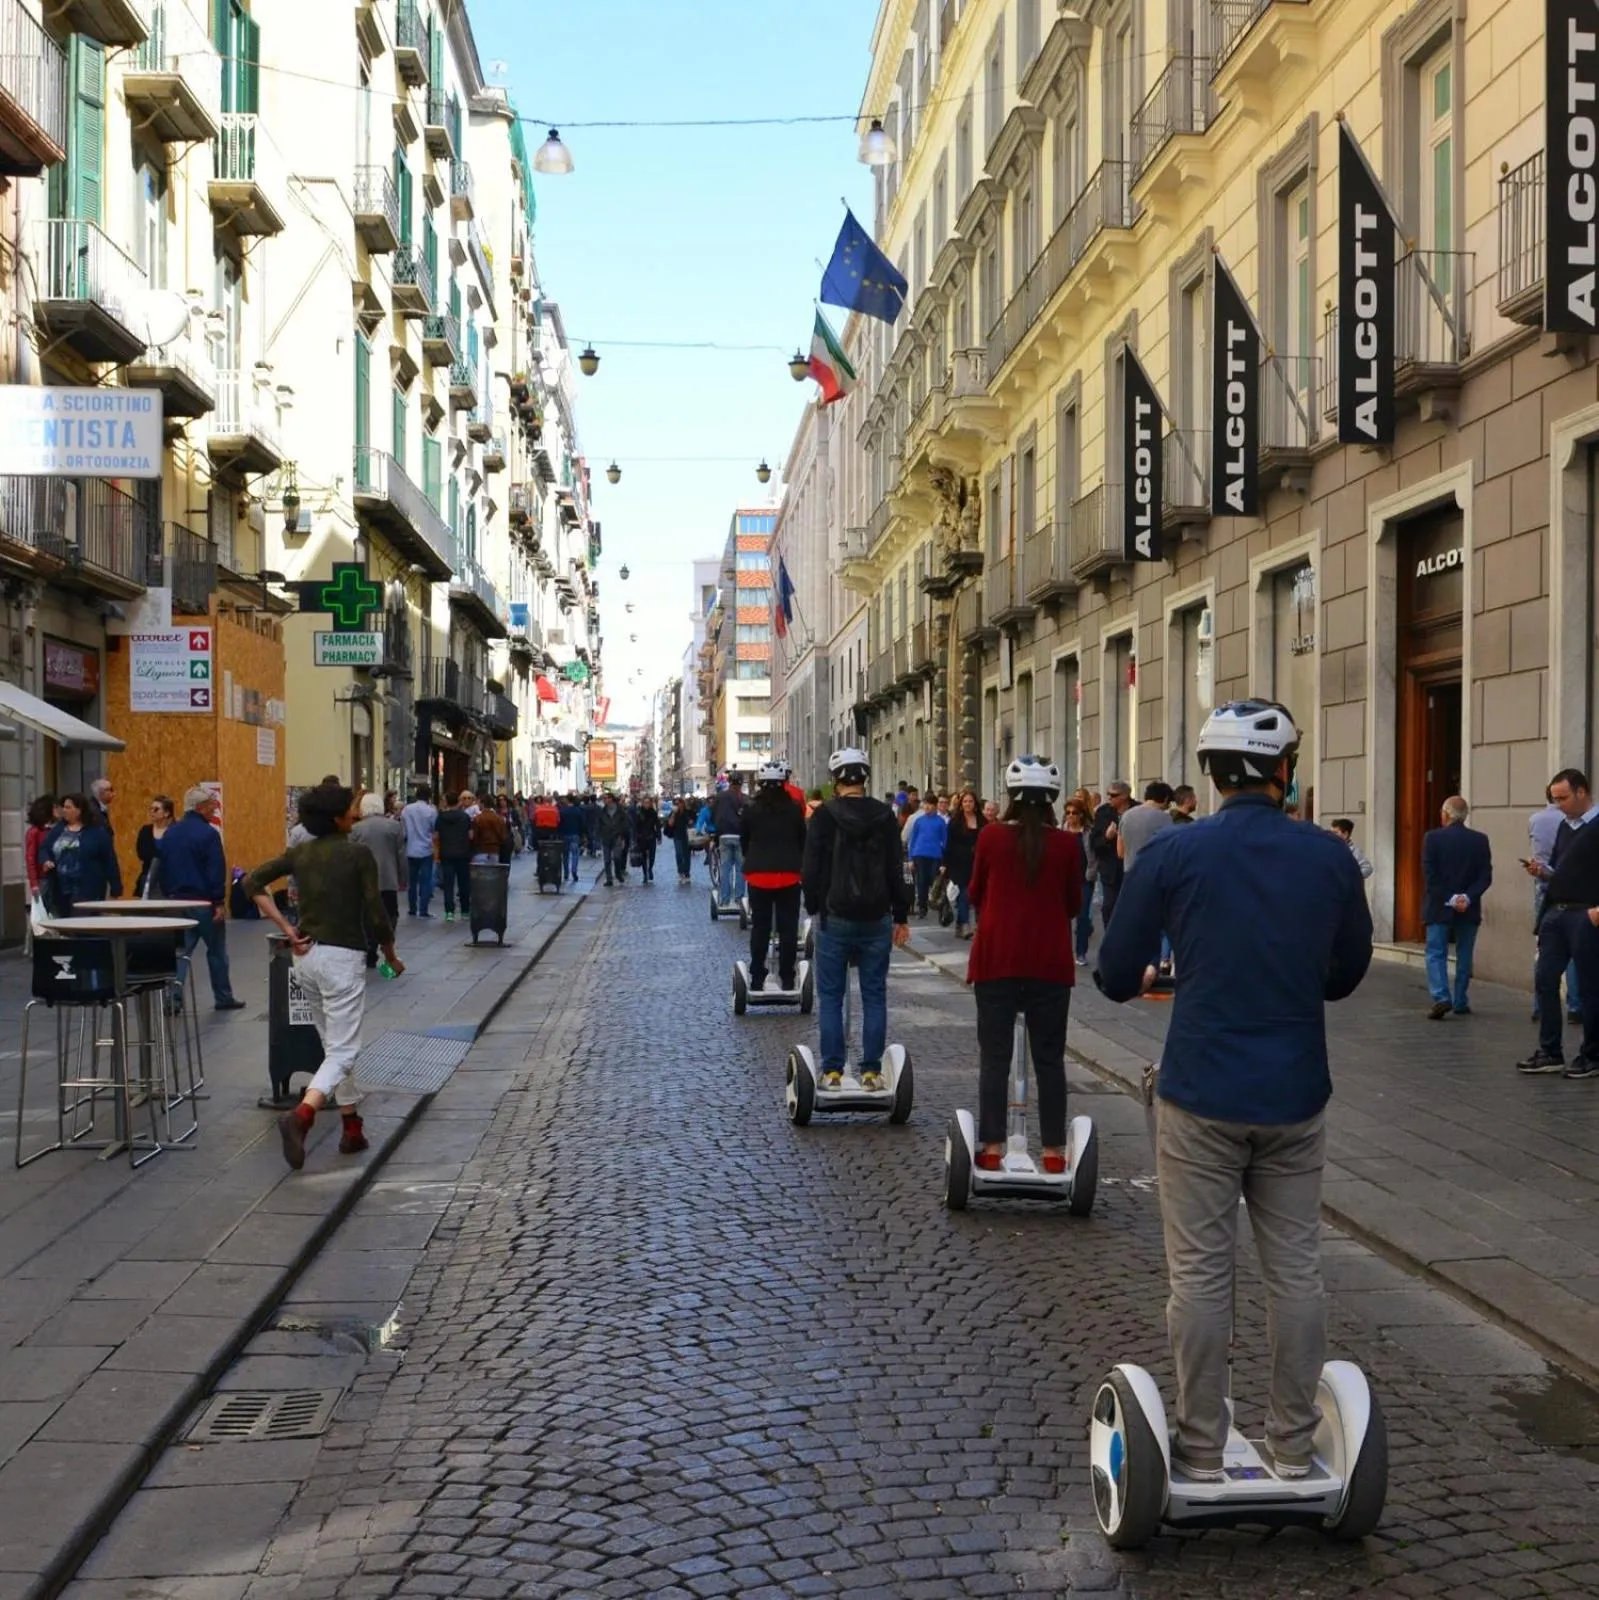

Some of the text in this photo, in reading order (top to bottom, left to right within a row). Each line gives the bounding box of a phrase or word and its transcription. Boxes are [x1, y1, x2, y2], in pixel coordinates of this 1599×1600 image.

[1568, 18, 1596, 327] ALCOTT
[1355, 203, 1378, 440] ALCOTT
[63, 394, 152, 412] SCIORTINO
[1226, 320, 1246, 512] ALCOTT
[66, 455, 150, 469] ORTODONZIA
[1135, 396, 1151, 558] ALCOTT
[322, 634, 376, 646] FARMACIA
[322, 651, 376, 662] PHARMACY
